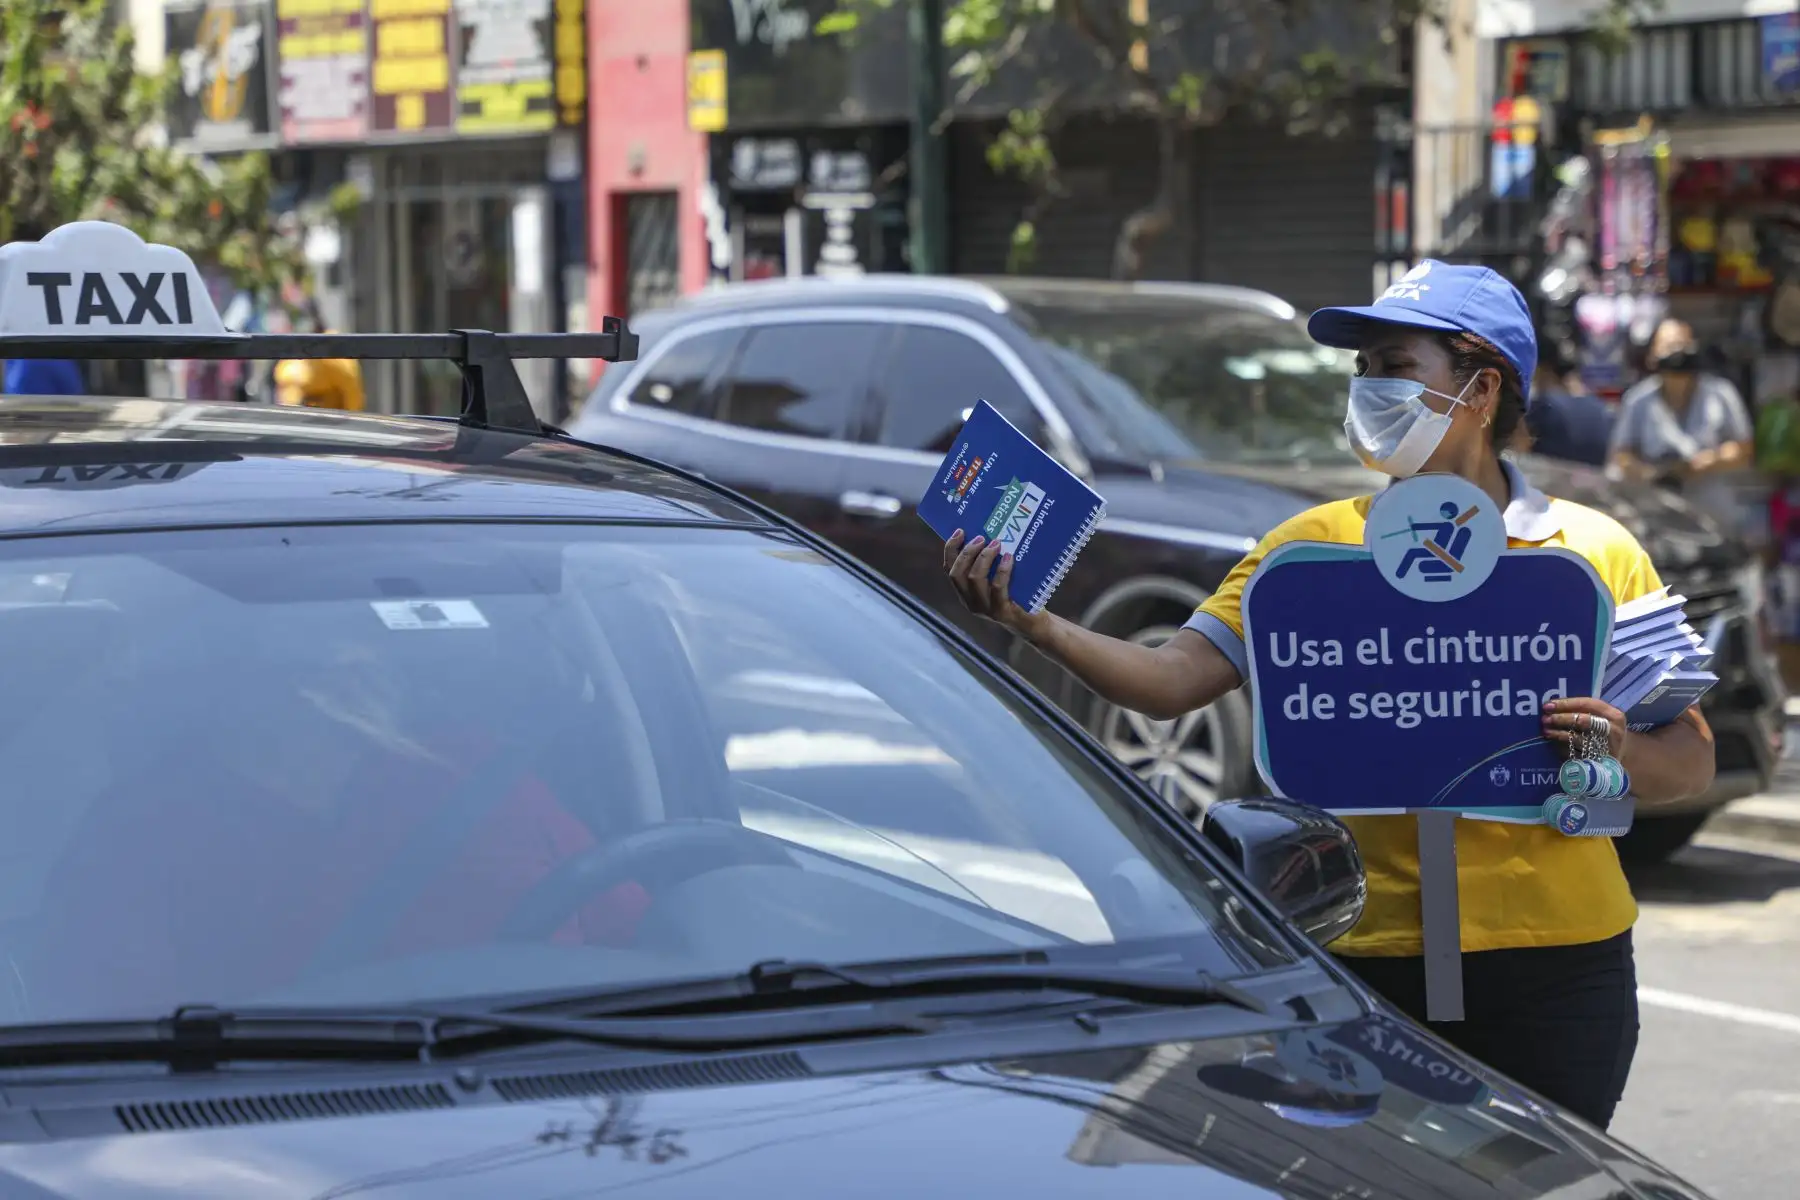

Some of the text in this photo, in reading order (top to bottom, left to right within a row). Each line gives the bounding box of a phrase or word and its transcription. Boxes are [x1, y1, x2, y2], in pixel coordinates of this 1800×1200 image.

[27, 272, 193, 325] TAXI
[943, 442, 969, 485] @MuniLima
[971, 459, 982, 471] 11
[983, 452, 998, 472] LUN
[968, 476, 982, 495] MIE
[957, 500, 969, 516] VIE
[986, 485, 1020, 533] Noticias
[1001, 492, 1039, 543] LIMA
[1016, 498, 1055, 562] Tu informativo
[1269, 622, 1583, 668] Usa el cinturón
[1283, 683, 1335, 721] de
[1520, 773, 1561, 787] LIM
